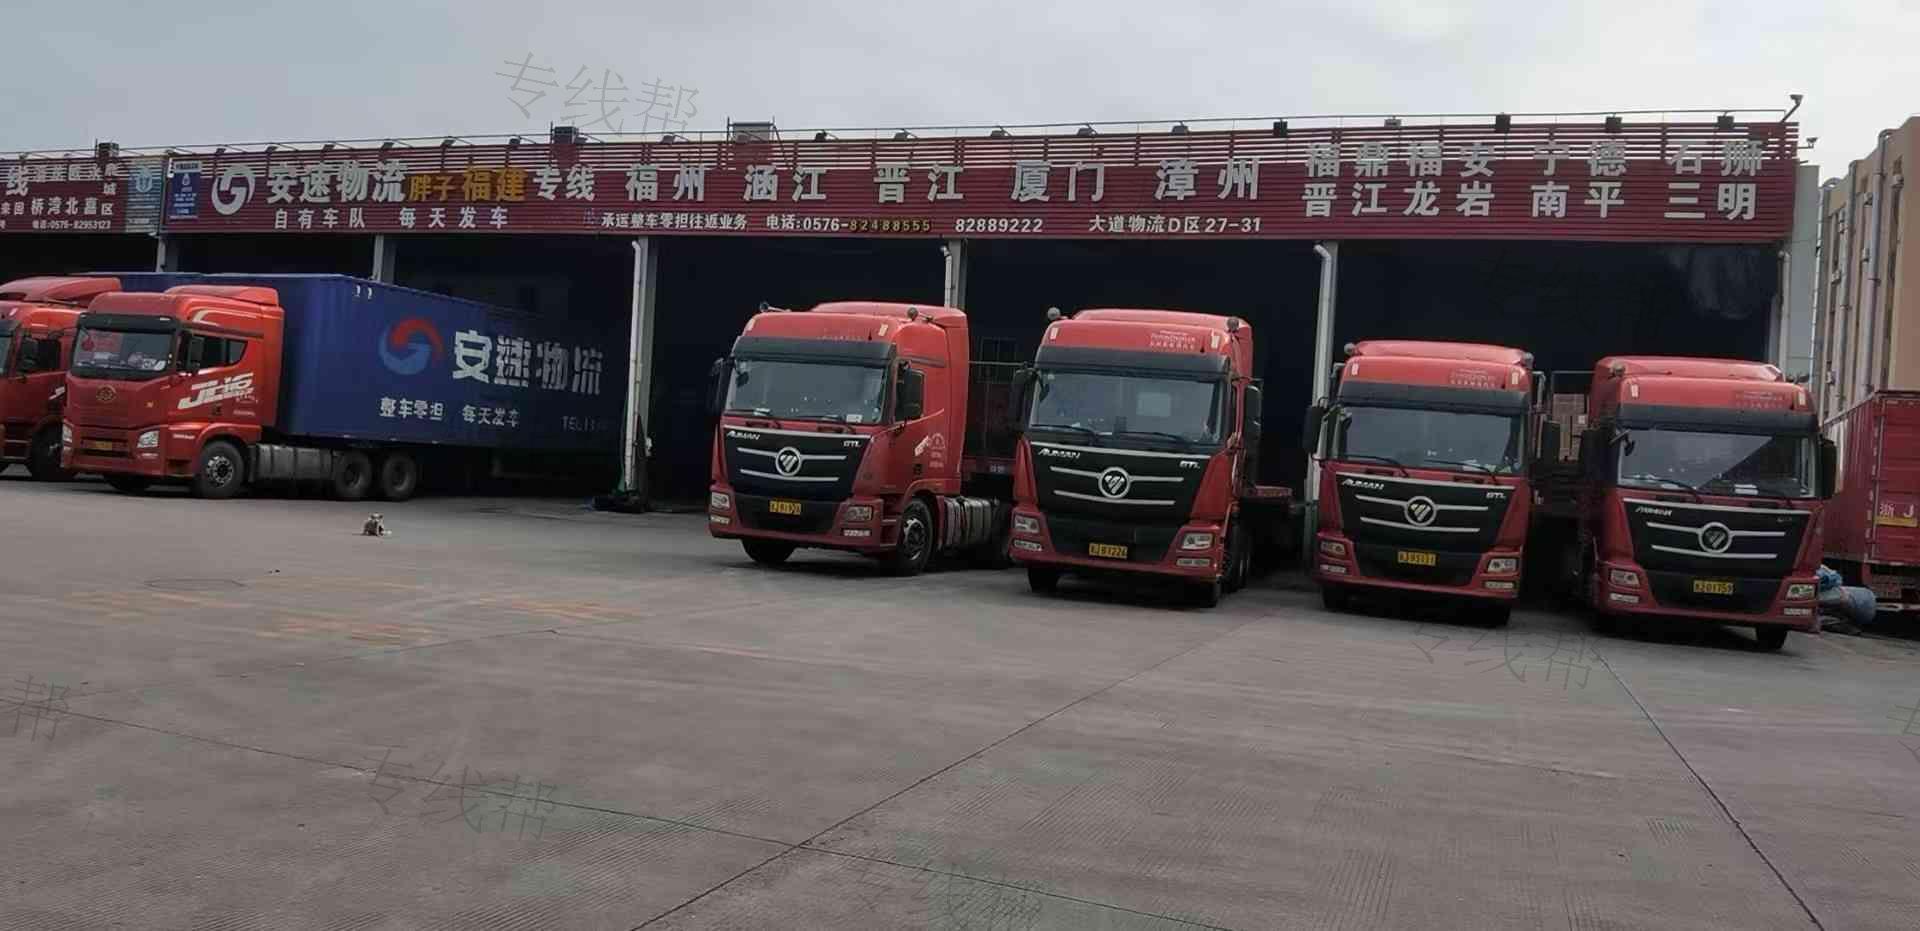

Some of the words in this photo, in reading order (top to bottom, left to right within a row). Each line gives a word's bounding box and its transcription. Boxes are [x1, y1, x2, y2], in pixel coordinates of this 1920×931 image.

[1304, 140, 1496, 178] 福鼎福安
[1531, 139, 1628, 177] 宁德
[1665, 139, 1764, 178] 石狮
[266, 160, 408, 204] 安速物流
[625, 163, 706, 201] 福州
[744, 164, 827, 201] 涵江
[873, 163, 964, 203] 晋江
[1011, 160, 1105, 203] 厦门
[1154, 157, 1260, 202] 漳州
[274, 207, 366, 230] 自有车队
[399, 206, 509, 229] 每天发车
[1301, 182, 1496, 218] 晋江龙岩
[1530, 182, 1625, 219] 南平
[1664, 182, 1758, 220] 三明
[955, 218, 1043, 233] 82889222
[452, 329, 604, 395] 安速物流
[379, 397, 447, 421] 整车零担
[461, 404, 520, 428] 每天发车
